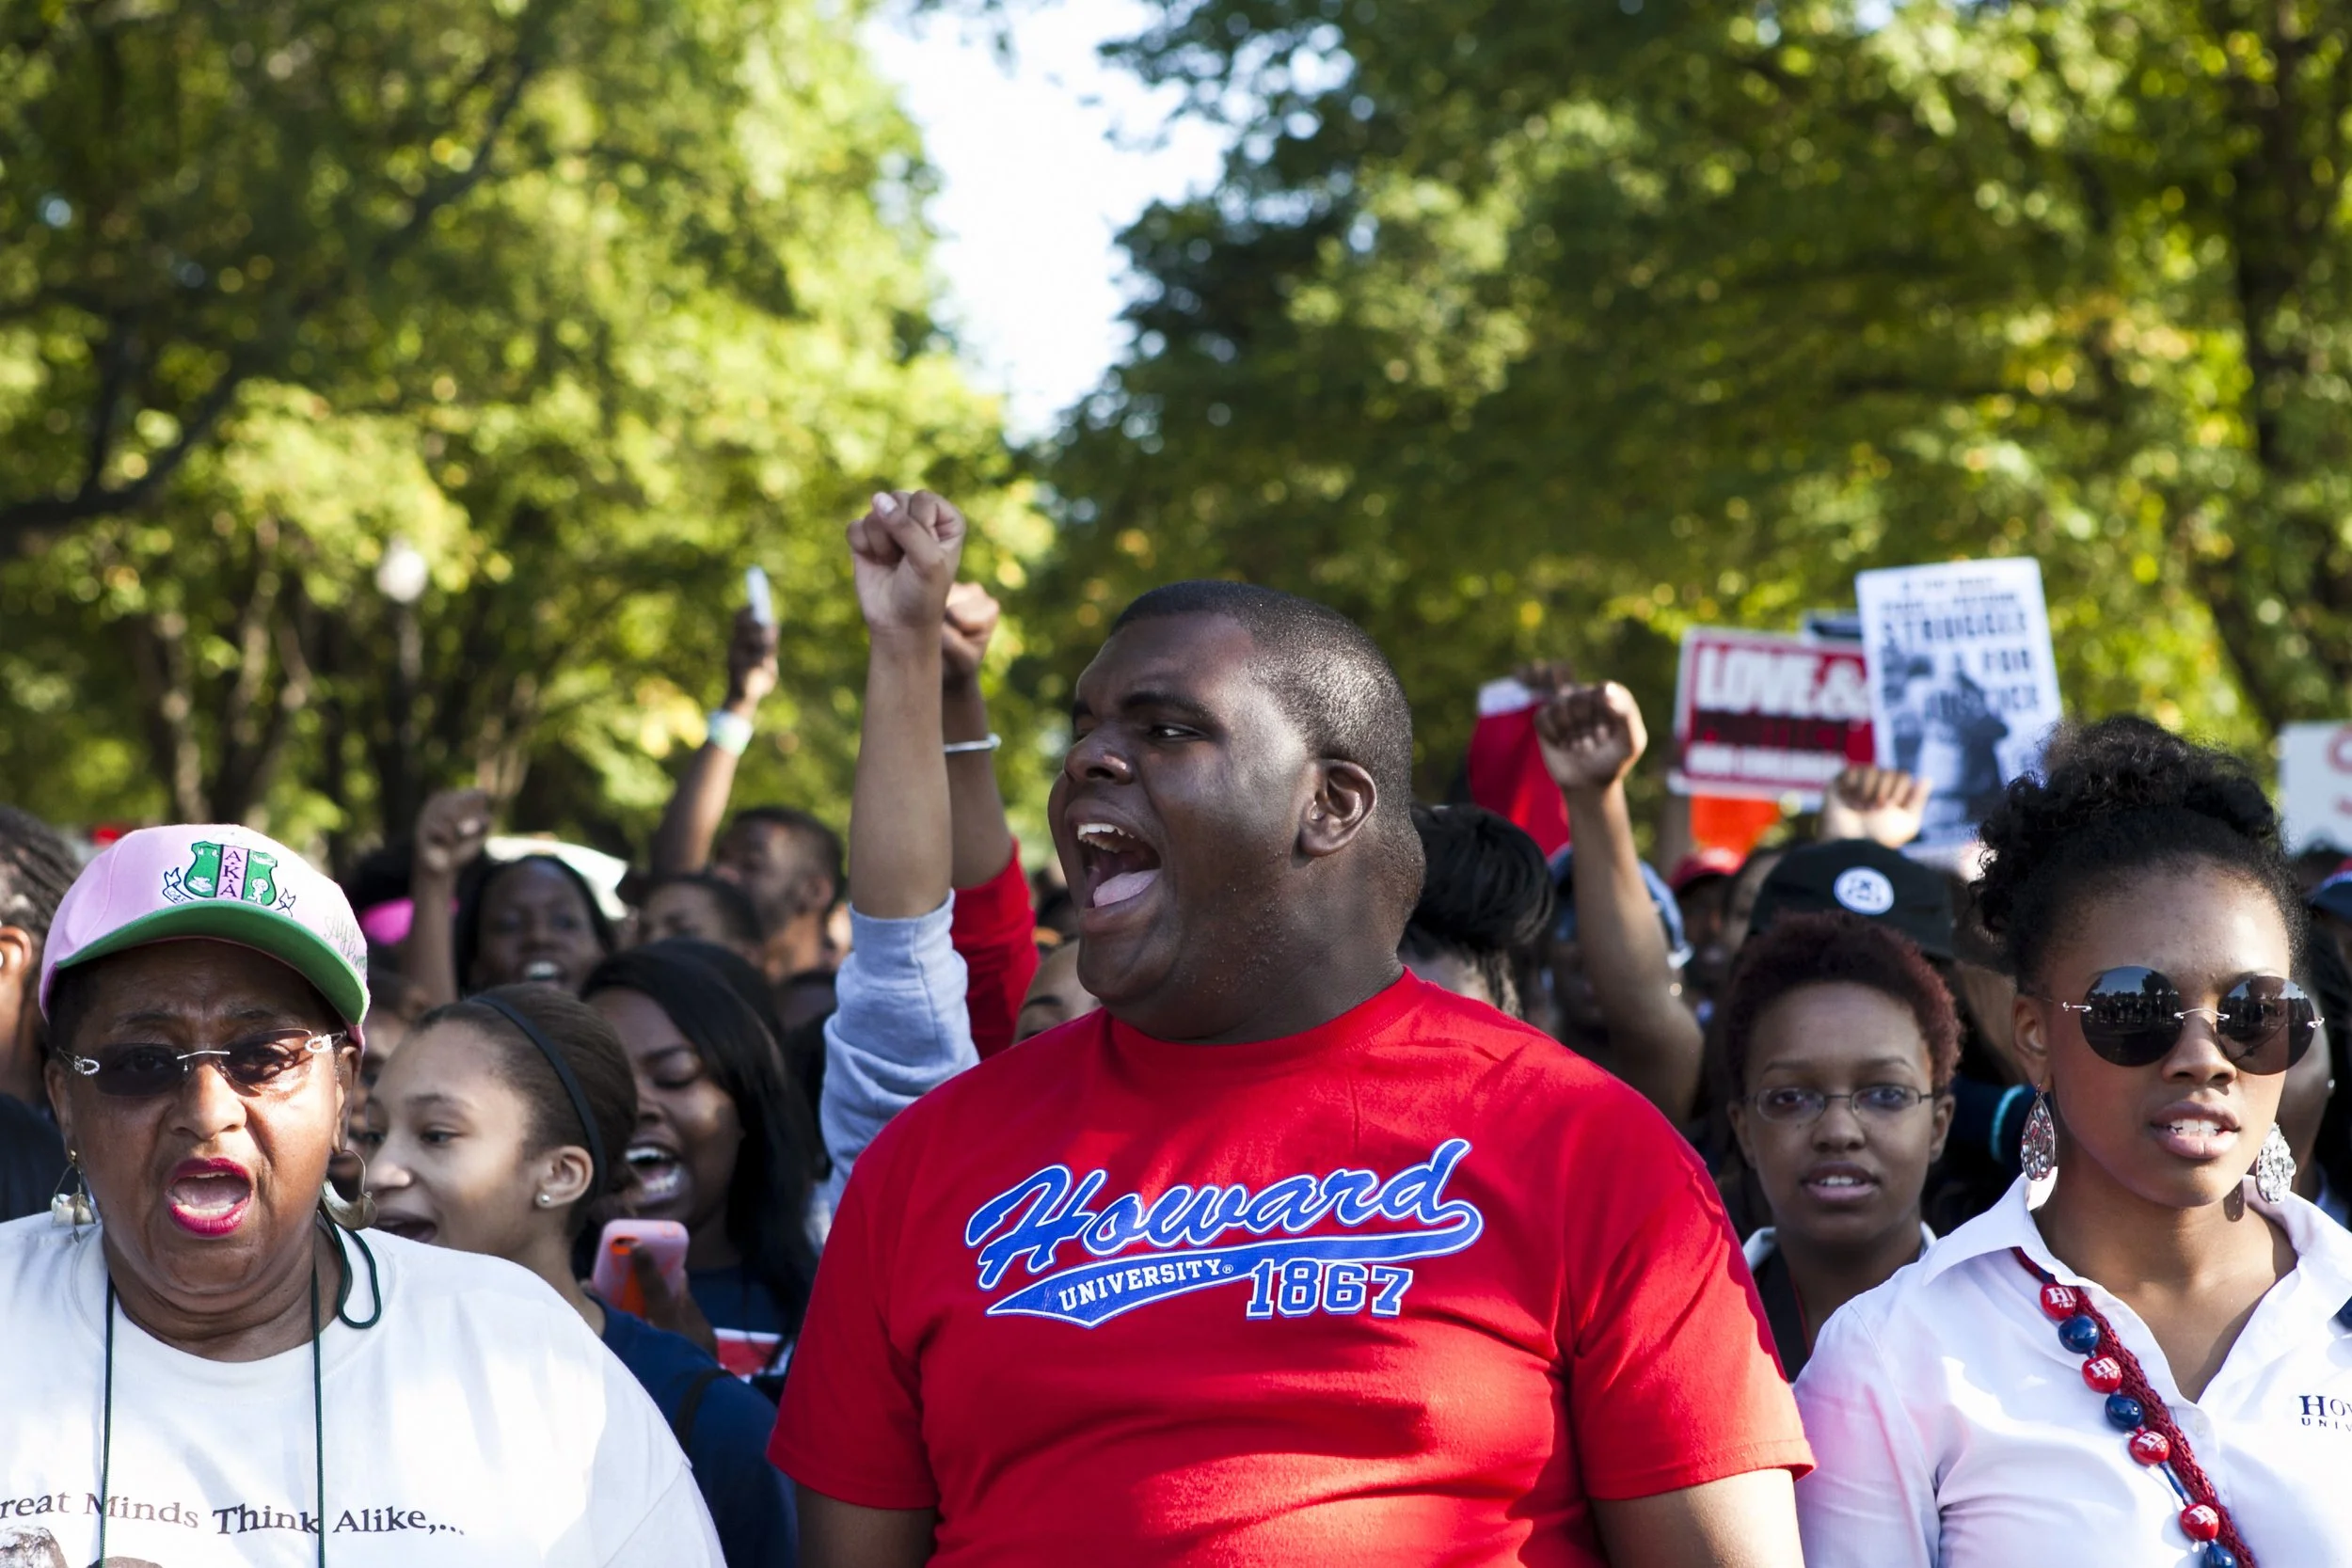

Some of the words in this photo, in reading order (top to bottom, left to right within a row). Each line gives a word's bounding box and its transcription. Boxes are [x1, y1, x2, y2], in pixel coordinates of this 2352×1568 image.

[964, 1138, 1473, 1291] Howard
[1247, 1257, 1413, 1319] 1867
[84, 1493, 199, 1528] Minds
[212, 1503, 319, 1534] Think
